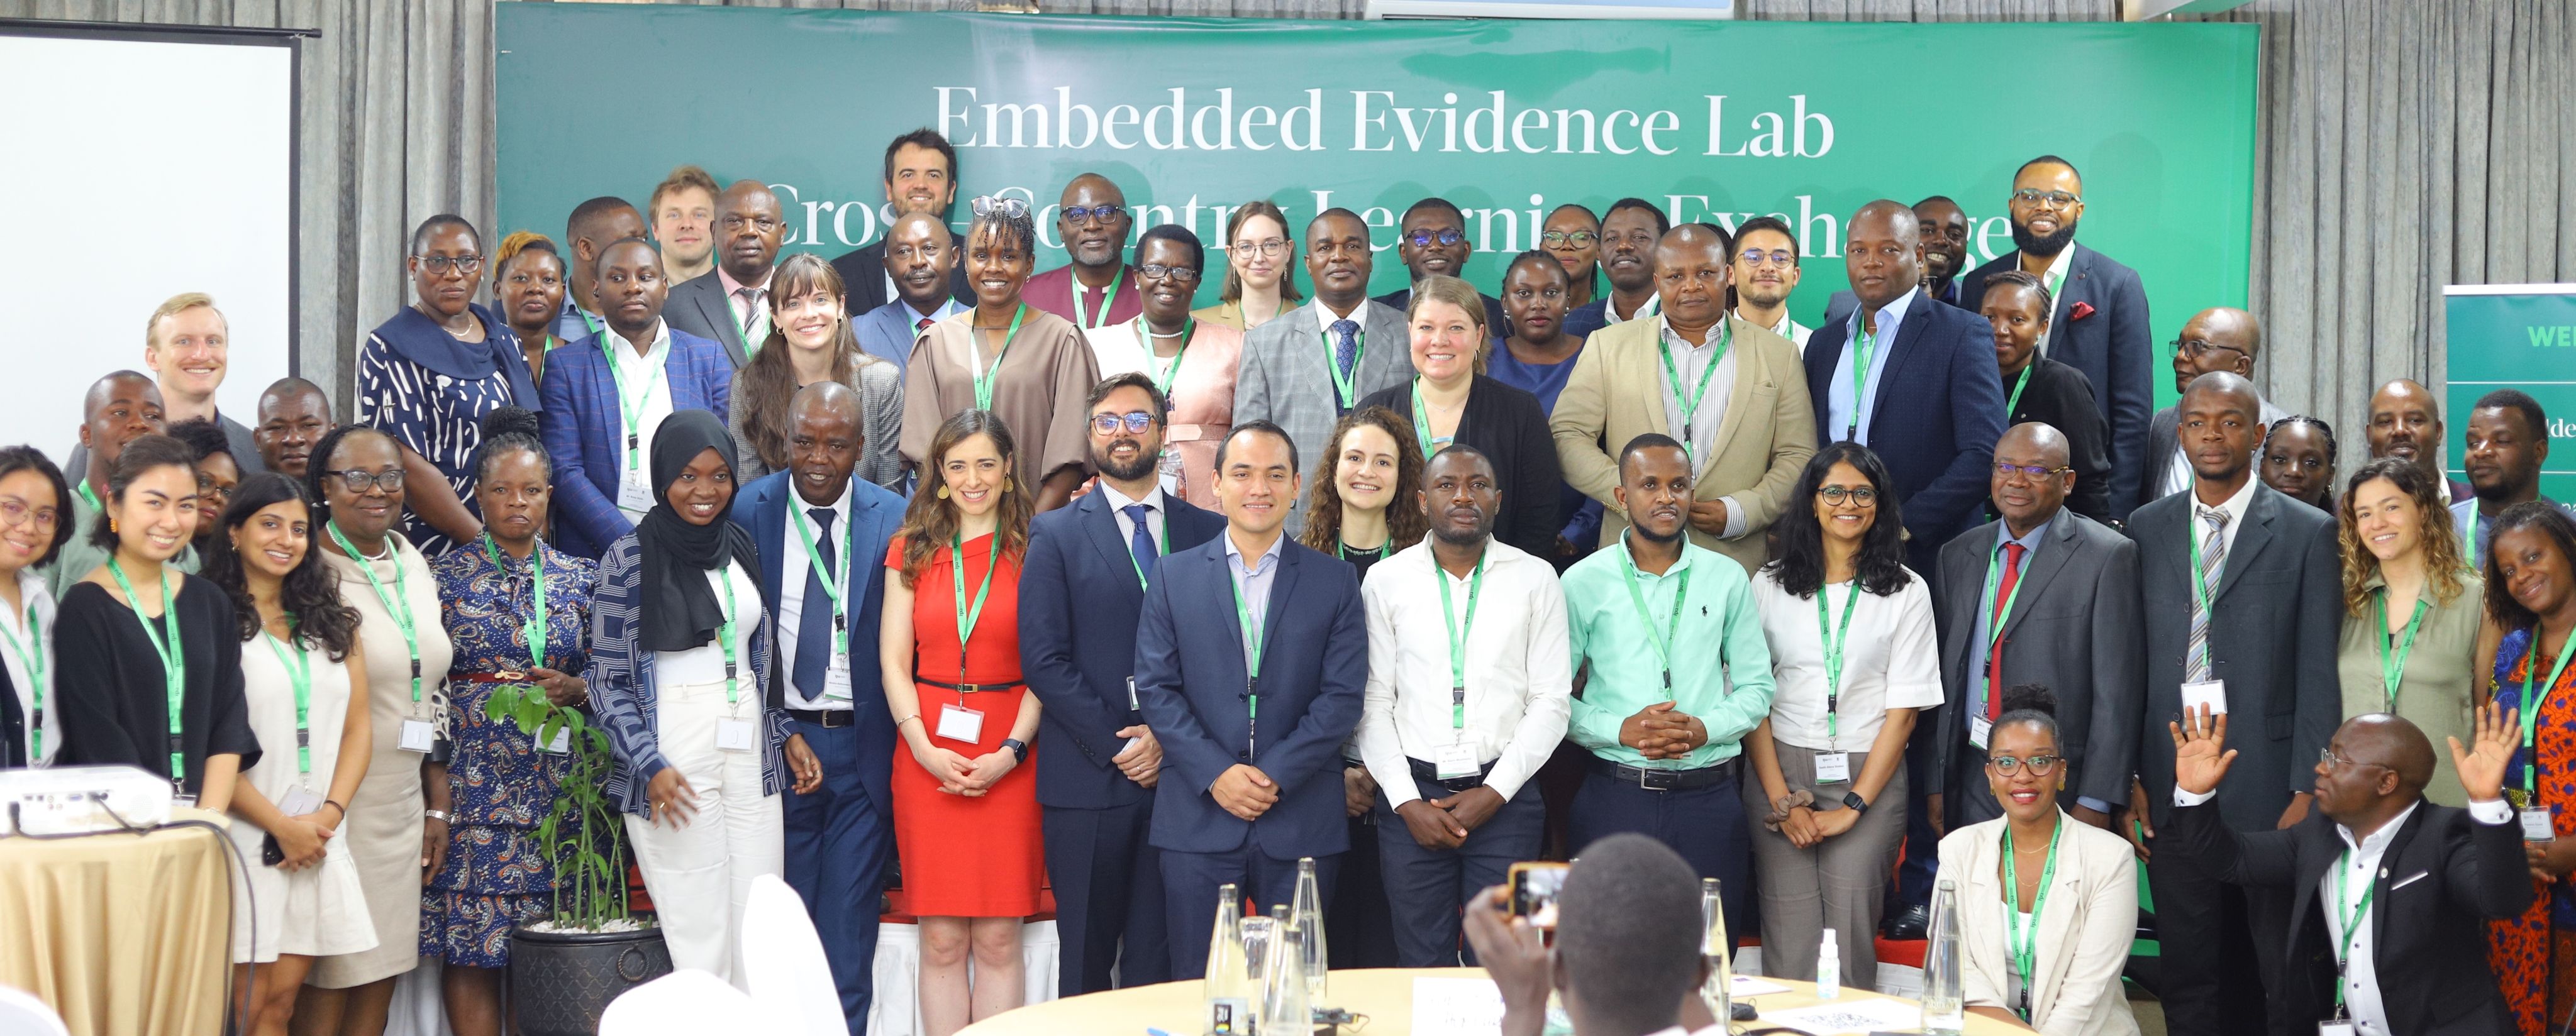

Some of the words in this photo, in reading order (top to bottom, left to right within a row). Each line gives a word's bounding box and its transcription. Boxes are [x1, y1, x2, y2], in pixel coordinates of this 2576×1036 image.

[933, 85, 1325, 151] Embedded
[1348, 90, 1680, 155] Evidence
[1702, 94, 1835, 158] Lab
